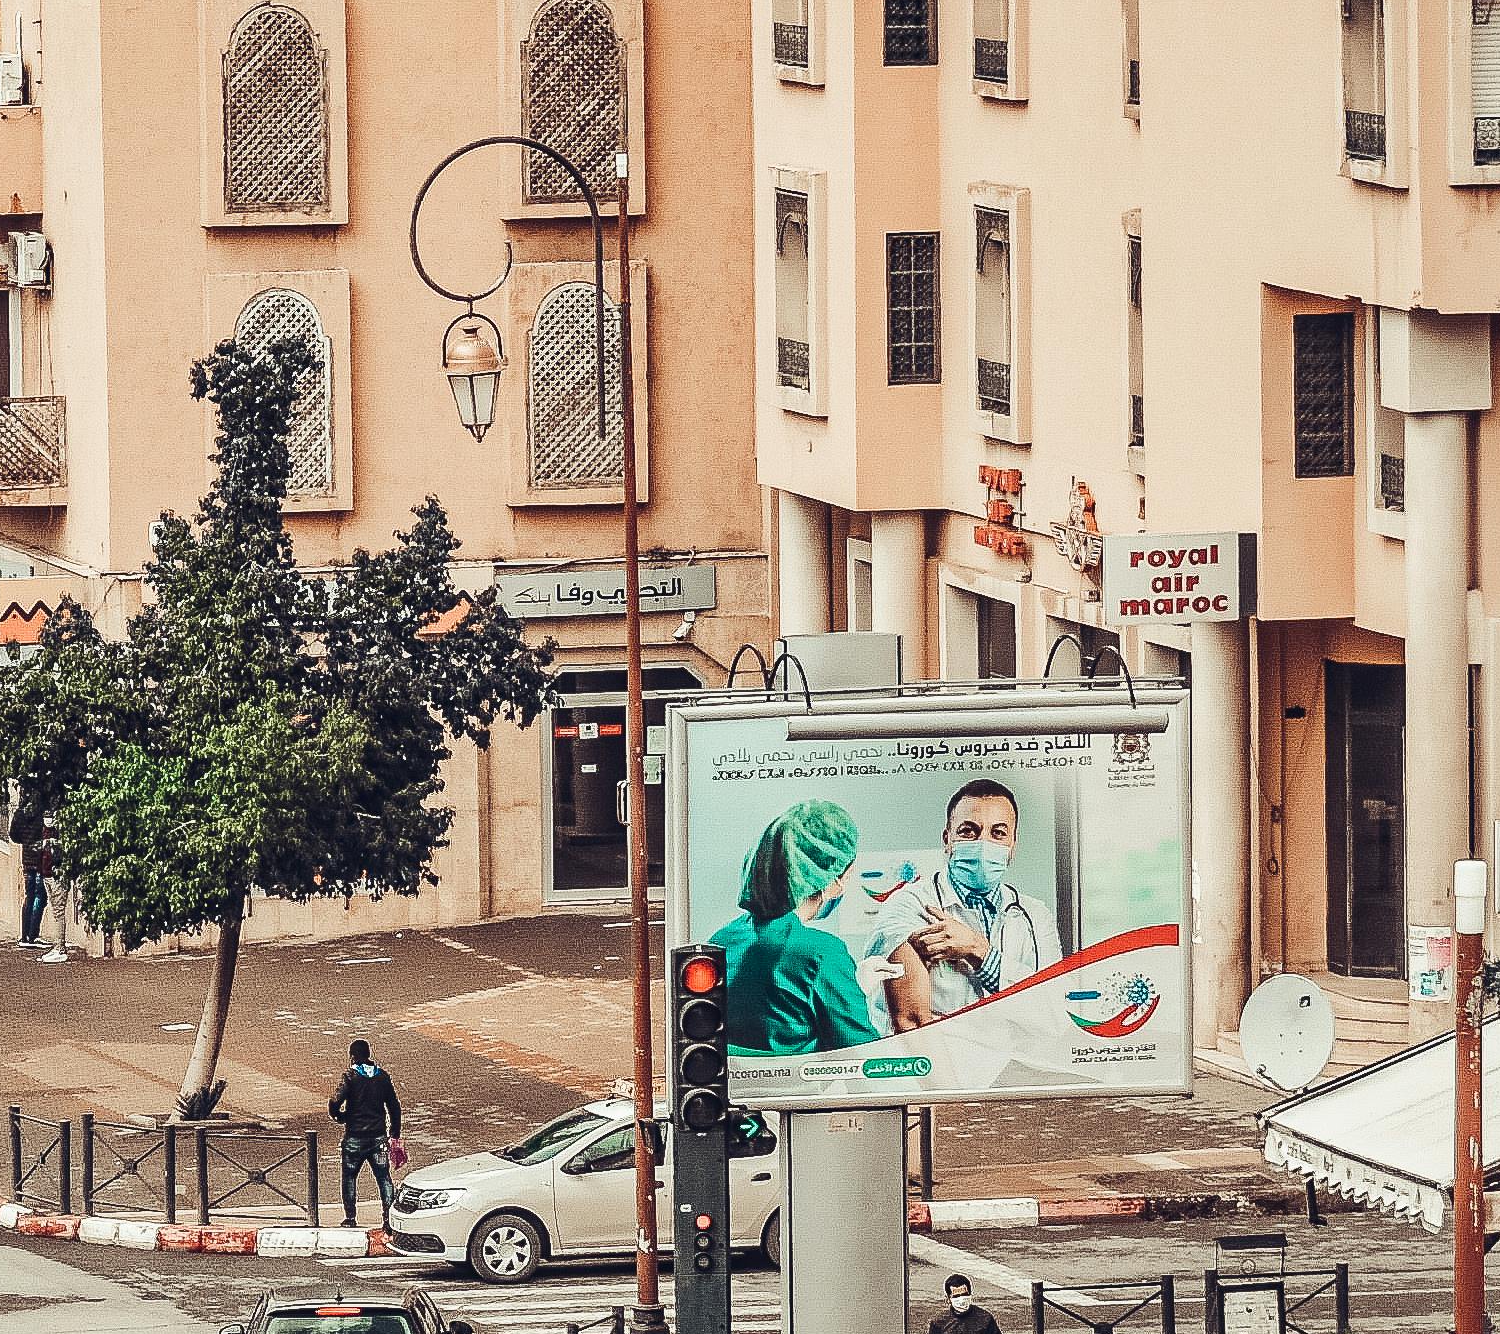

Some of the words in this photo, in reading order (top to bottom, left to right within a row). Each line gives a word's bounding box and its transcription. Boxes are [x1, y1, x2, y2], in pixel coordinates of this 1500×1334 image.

[1130, 544, 1219, 568] royal
[597, 577, 682, 604] التجي
[1151, 573, 1200, 593] air
[514, 587, 551, 606] بنك
[556, 582, 594, 606] وفا
[1120, 594, 1228, 616] maroc
[954, 738, 1010, 758] فيروس
[1014, 737, 1040, 752] ضد
[1045, 734, 1092, 755] اللقاح
